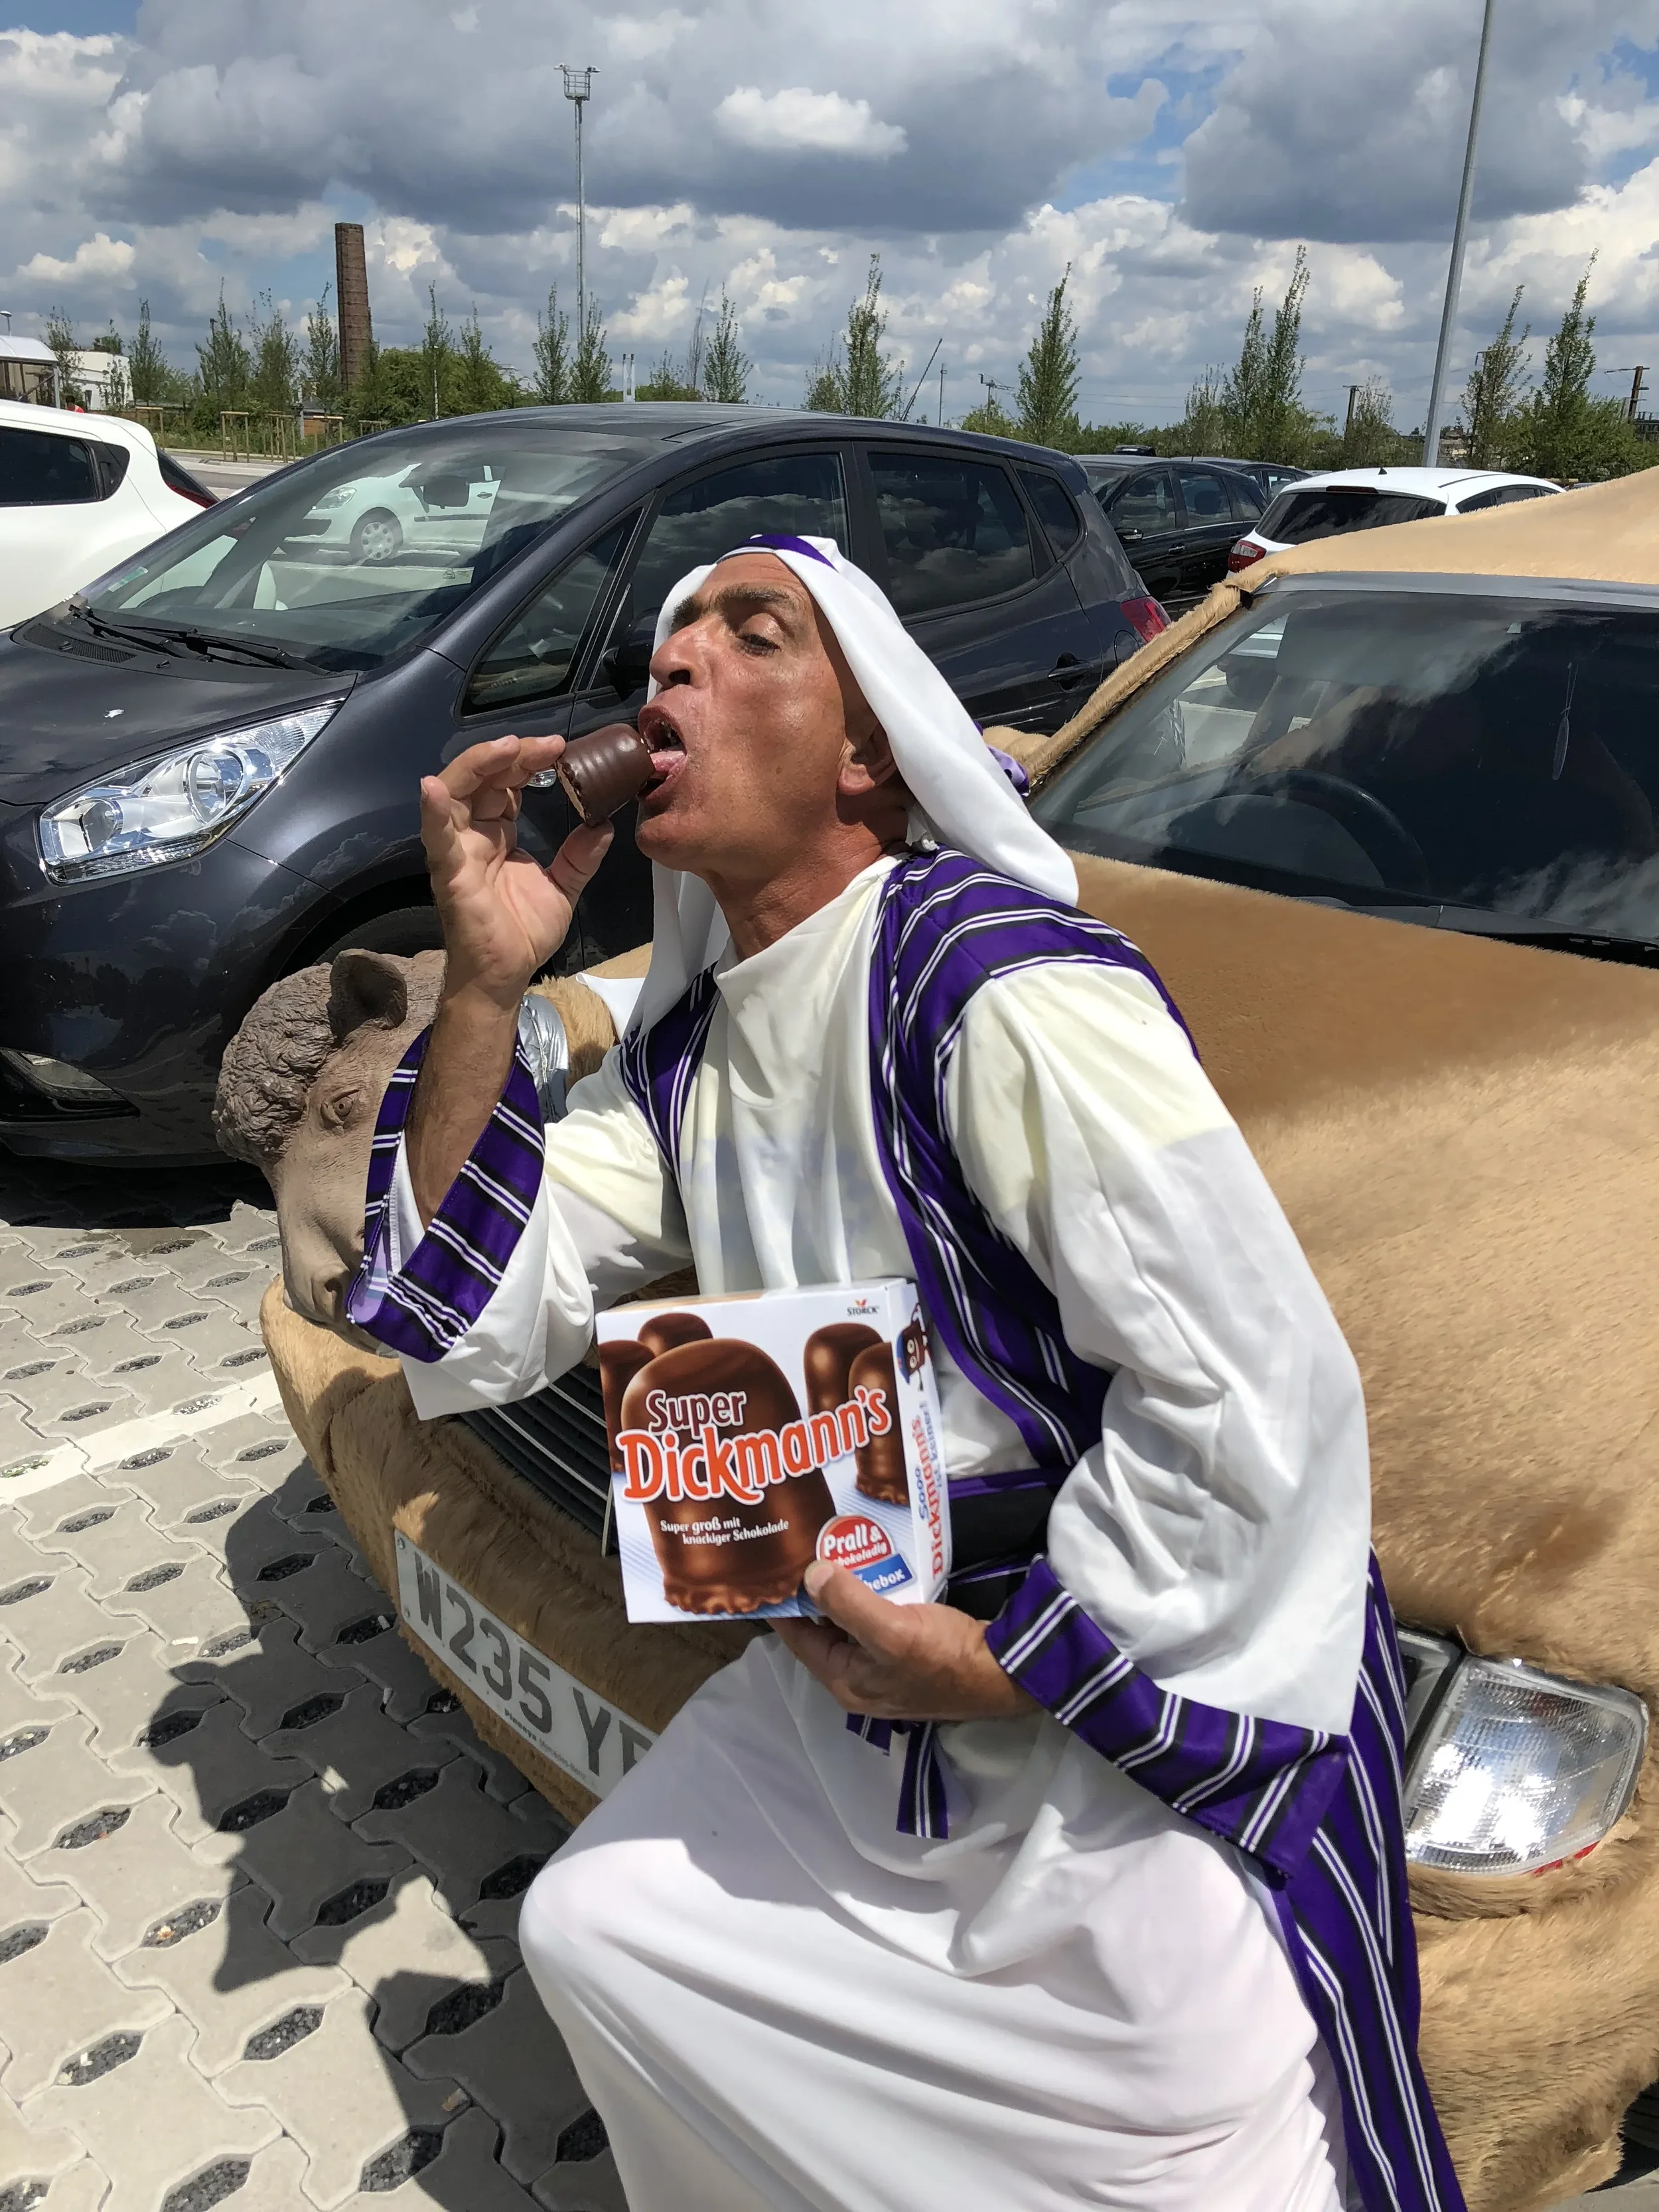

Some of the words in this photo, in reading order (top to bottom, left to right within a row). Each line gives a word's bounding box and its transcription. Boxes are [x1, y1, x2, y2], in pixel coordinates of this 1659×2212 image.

[847, 1305, 878, 1317] STORCK
[648, 1391, 747, 1438] Super
[617, 1385, 892, 1505] Dickmann's
[912, 1416, 944, 1581] Dickmann's
[914, 1467, 929, 1521] Sooo
[660, 1519, 689, 1534] Super
[691, 1516, 721, 1535] groß
[723, 1516, 741, 1529] mit
[682, 1533, 731, 1546] knackiger
[733, 1518, 790, 1542] Schokolade
[824, 1523, 869, 1557] Prall
[870, 1525, 883, 1542] &
[414, 1551, 552, 1734] W235
